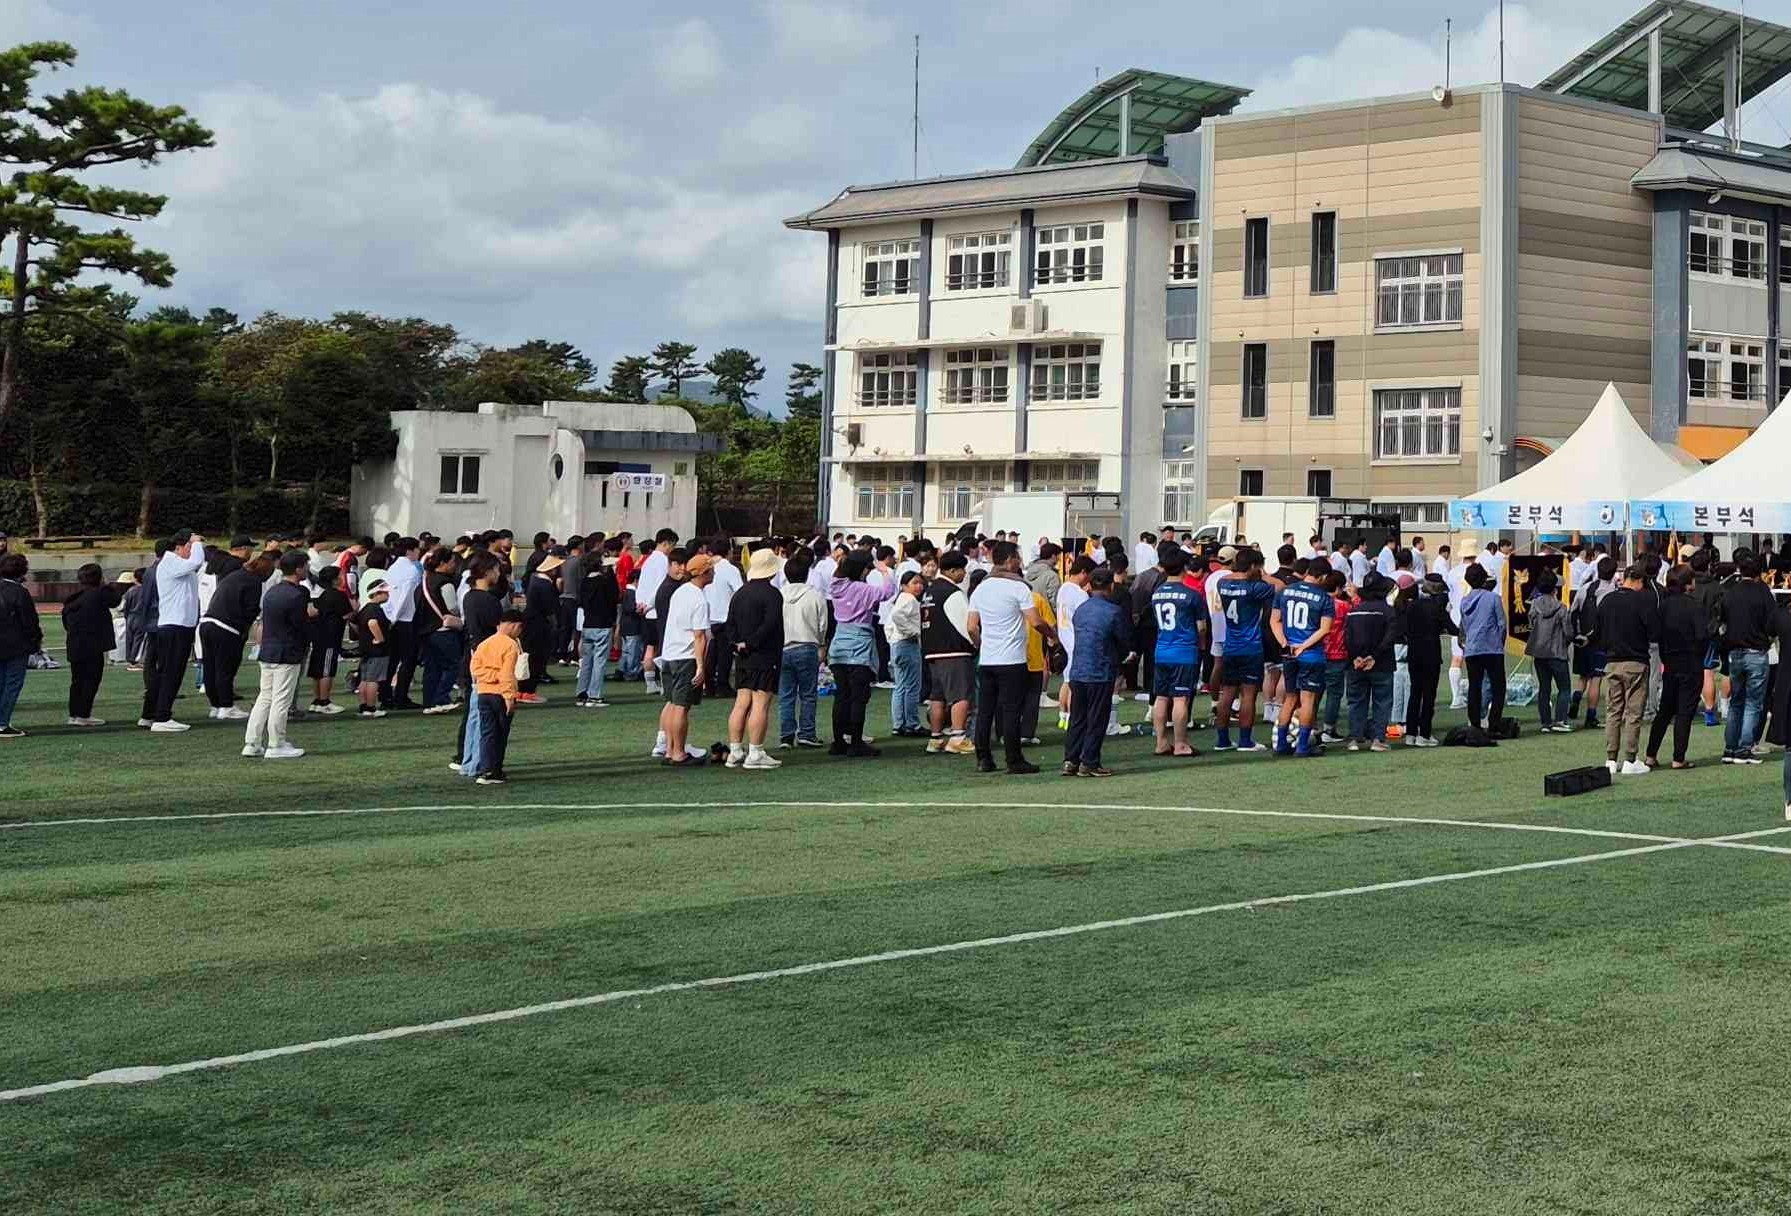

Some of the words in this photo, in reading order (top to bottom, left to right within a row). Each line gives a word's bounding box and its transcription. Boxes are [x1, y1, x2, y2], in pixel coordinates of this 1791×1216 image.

[1508, 506, 1563, 525] 본부석
[1694, 506, 1755, 527] 본부석
[1154, 602, 1177, 631] 13
[1226, 599, 1239, 625] 4
[1286, 599, 1309, 630] 10
